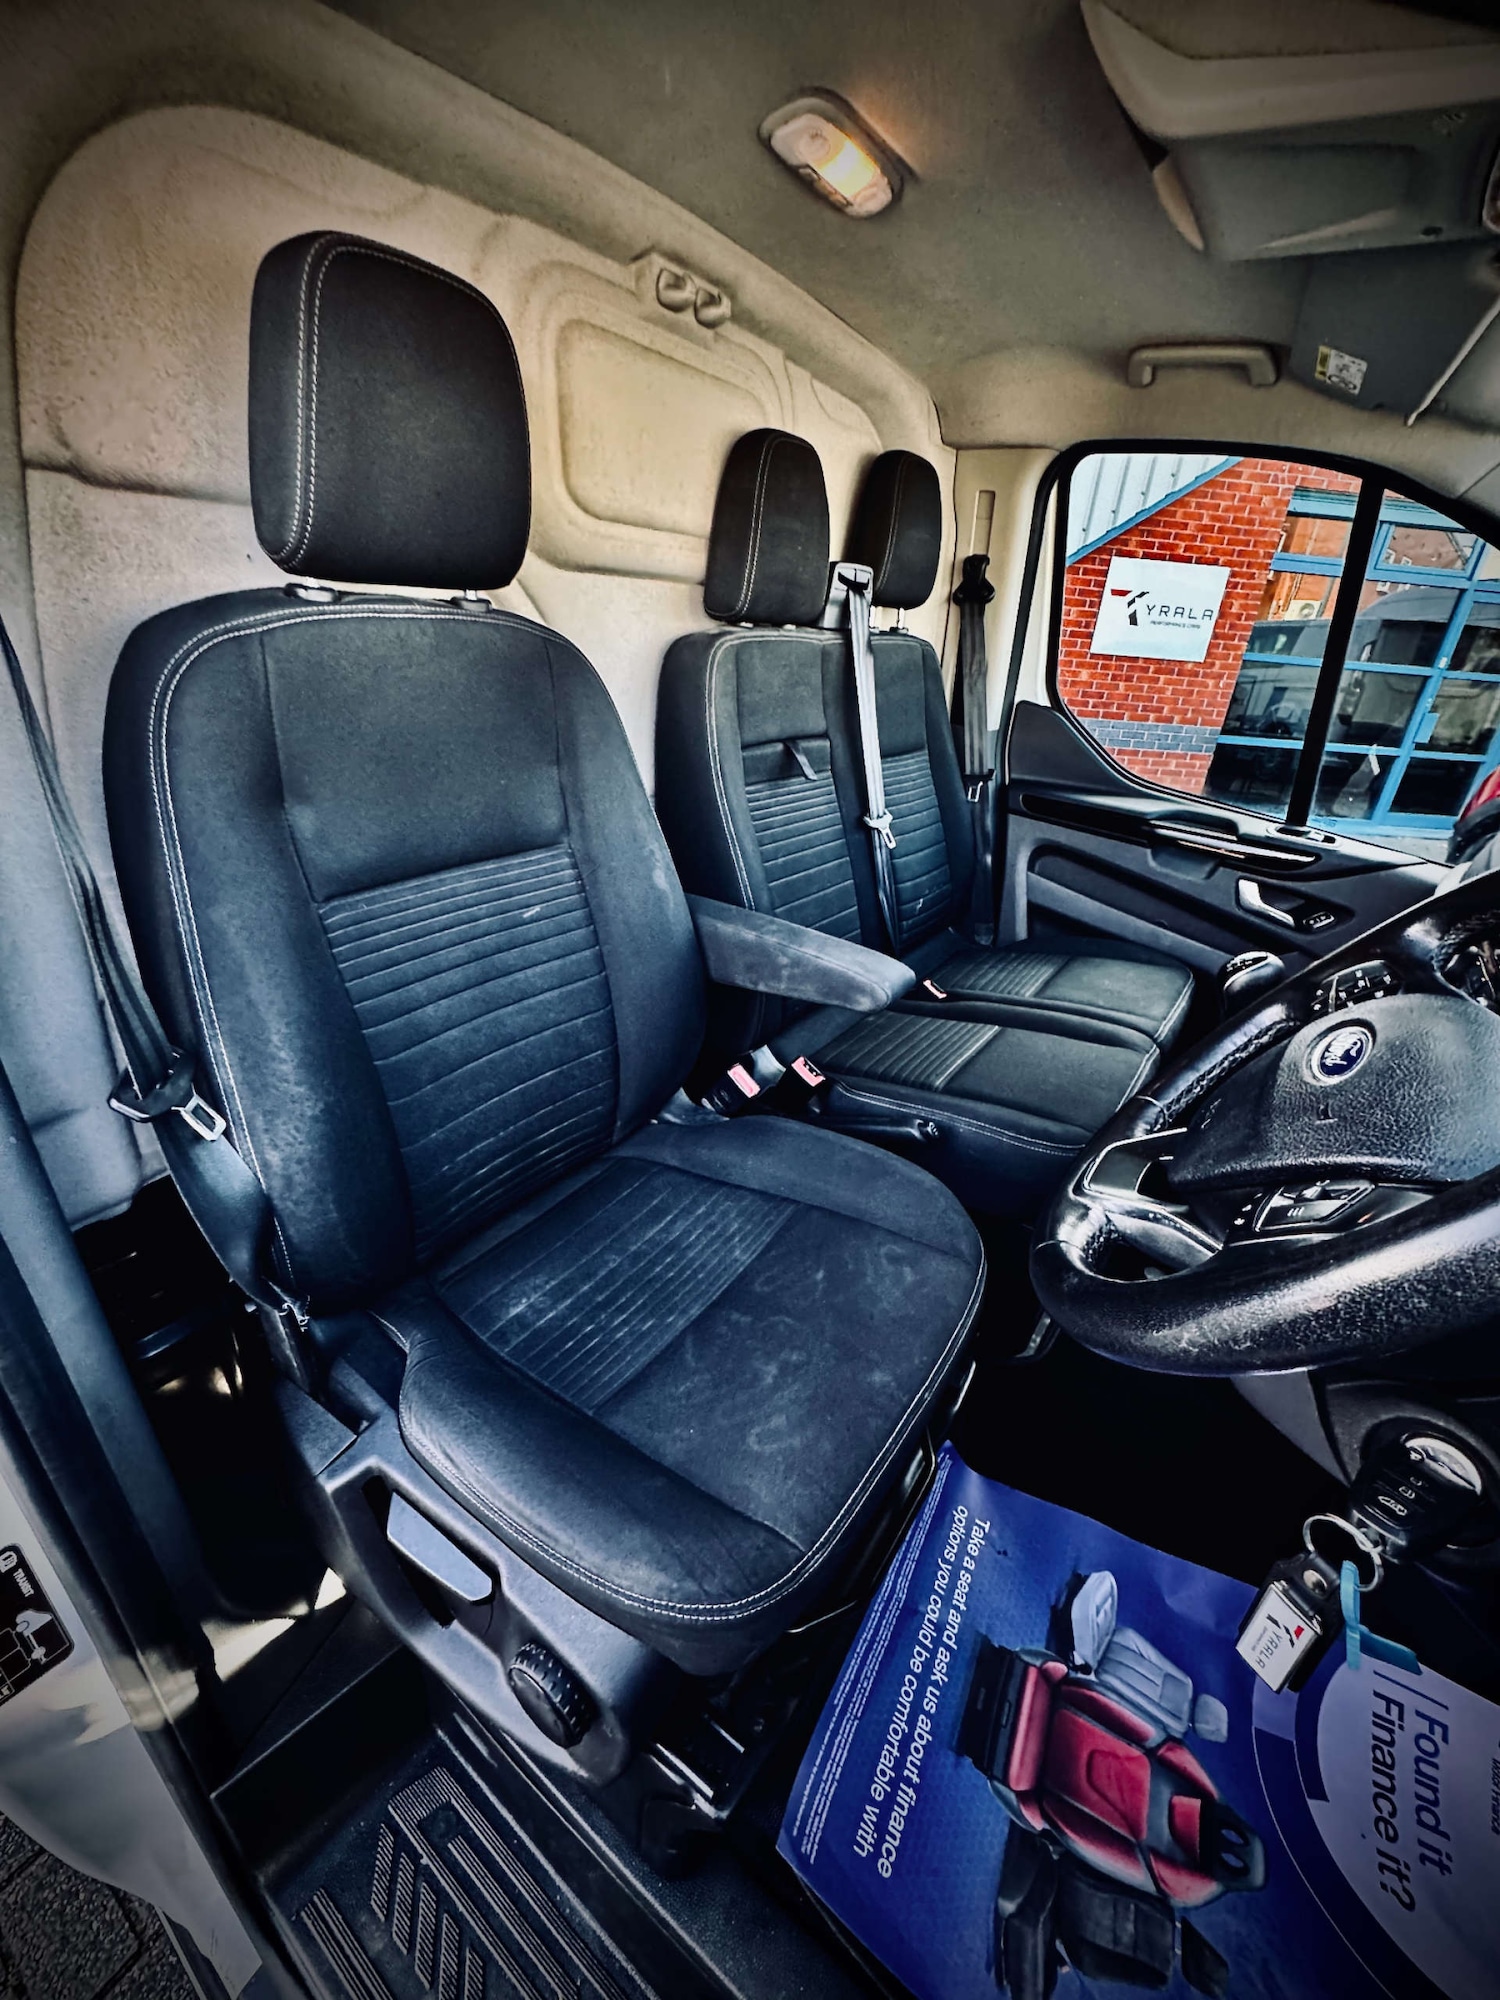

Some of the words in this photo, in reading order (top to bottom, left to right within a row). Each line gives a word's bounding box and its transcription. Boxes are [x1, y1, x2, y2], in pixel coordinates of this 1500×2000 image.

[944, 1505, 968, 1561] options
[967, 1518, 990, 1556] Take
[13, 1567, 34, 1598] TRANSIT
[934, 1558, 952, 1595] you
[963, 1556, 975, 1570] a
[952, 1570, 971, 1611] seat
[918, 1595, 941, 1649] could
[942, 1609, 961, 1650] and
[910, 1645, 930, 1673] be
[931, 1647, 950, 1686] ask
[923, 1686, 940, 1714] us
[871, 1674, 917, 1801] comfortable
[903, 1714, 932, 1784] about
[1371, 1689, 1405, 1845] Finance
[1414, 1708, 1451, 1842] Found
[853, 1804, 879, 1857] with
[877, 1782, 917, 1878] finance
[1417, 1837, 1453, 1876] it
[1376, 1847, 1416, 1912] it?
